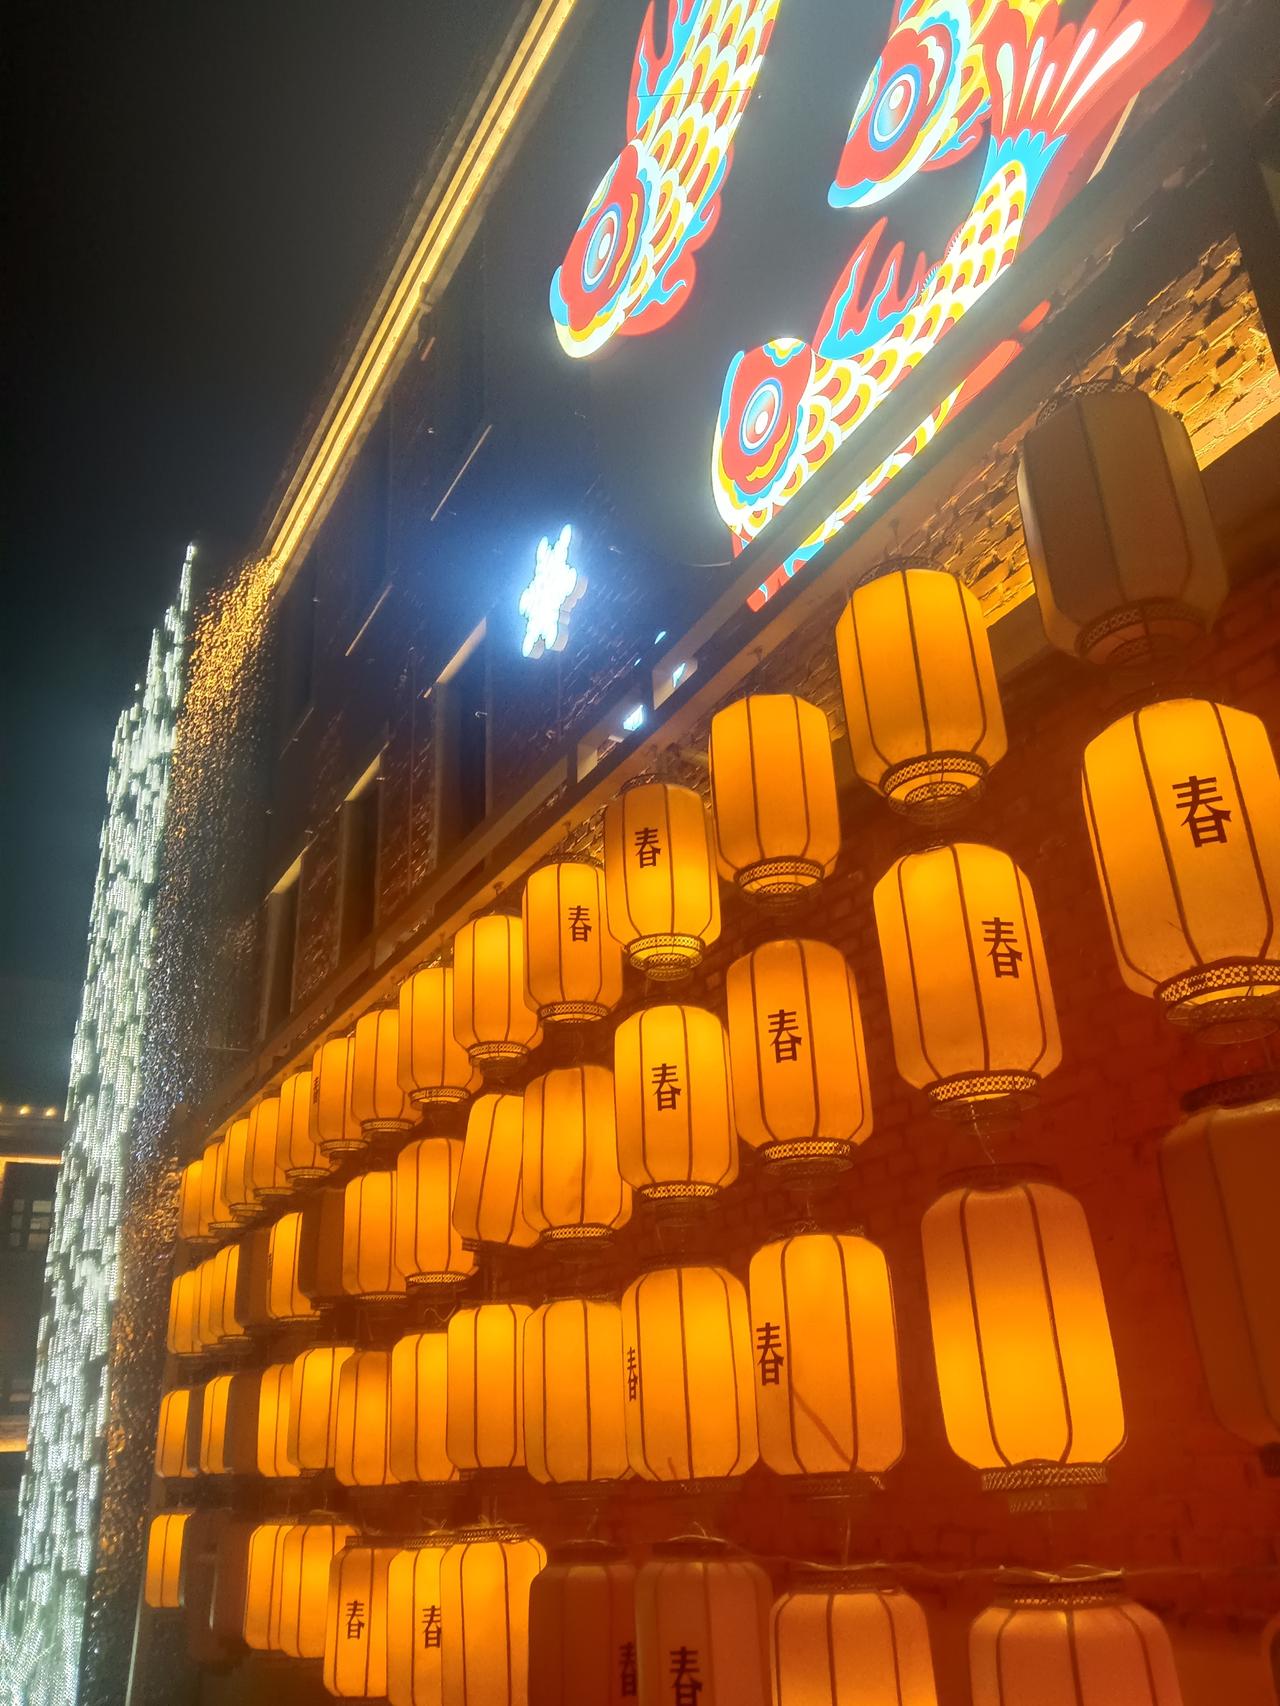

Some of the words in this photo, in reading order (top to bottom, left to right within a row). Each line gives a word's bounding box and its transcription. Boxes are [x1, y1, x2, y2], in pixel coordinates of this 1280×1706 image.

[1172, 775, 1232, 848] 春
[635, 827, 661, 869] 春
[568, 905, 592, 942] 春
[981, 917, 1023, 979] 春
[767, 1009, 802, 1064] 春
[651, 1063, 682, 1111] 春
[626, 1347, 639, 1402] 春
[756, 1322, 784, 1386] 春
[346, 1600, 365, 1640] 春
[421, 1605, 442, 1649] 春
[669, 1645, 703, 1706] 春
